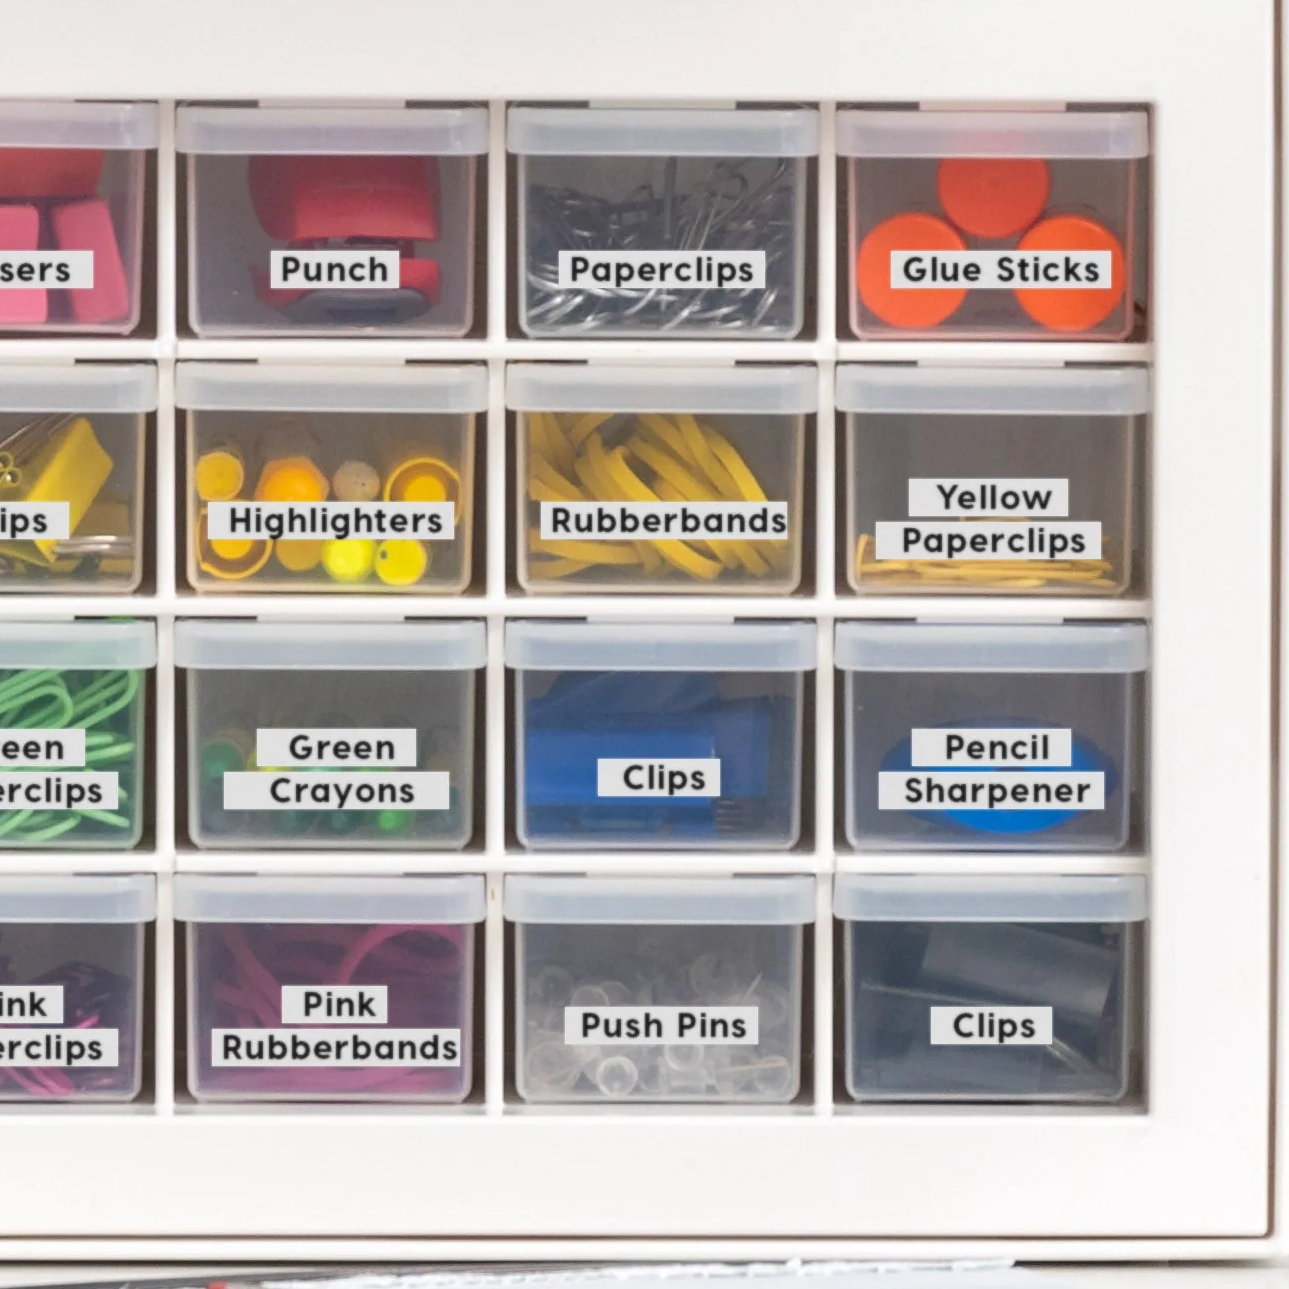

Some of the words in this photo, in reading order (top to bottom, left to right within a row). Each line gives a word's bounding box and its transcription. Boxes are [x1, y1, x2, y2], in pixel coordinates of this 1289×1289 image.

[282, 256, 388, 282] Punch
[571, 256, 754, 288] Paperclips
[903, 256, 981, 282] Glue
[997, 256, 1100, 283] Sticks
[936, 484, 1052, 510] Yellow
[230, 507, 443, 539] Highlighters
[552, 507, 787, 534] Rubberbands
[903, 527, 1086, 559] Paperclips
[289, 734, 395, 761] Green
[946, 734, 1049, 760] Pencil
[270, 777, 415, 809] Crayons
[623, 764, 706, 796] Clips
[905, 777, 1091, 809] Sharpener
[304, 991, 376, 1017] Pink
[582, 1012, 663, 1039] Push
[678, 1012, 747, 1039] Pins
[953, 1012, 1036, 1044] Clips
[223, 1034, 458, 1061] Rubberbands
